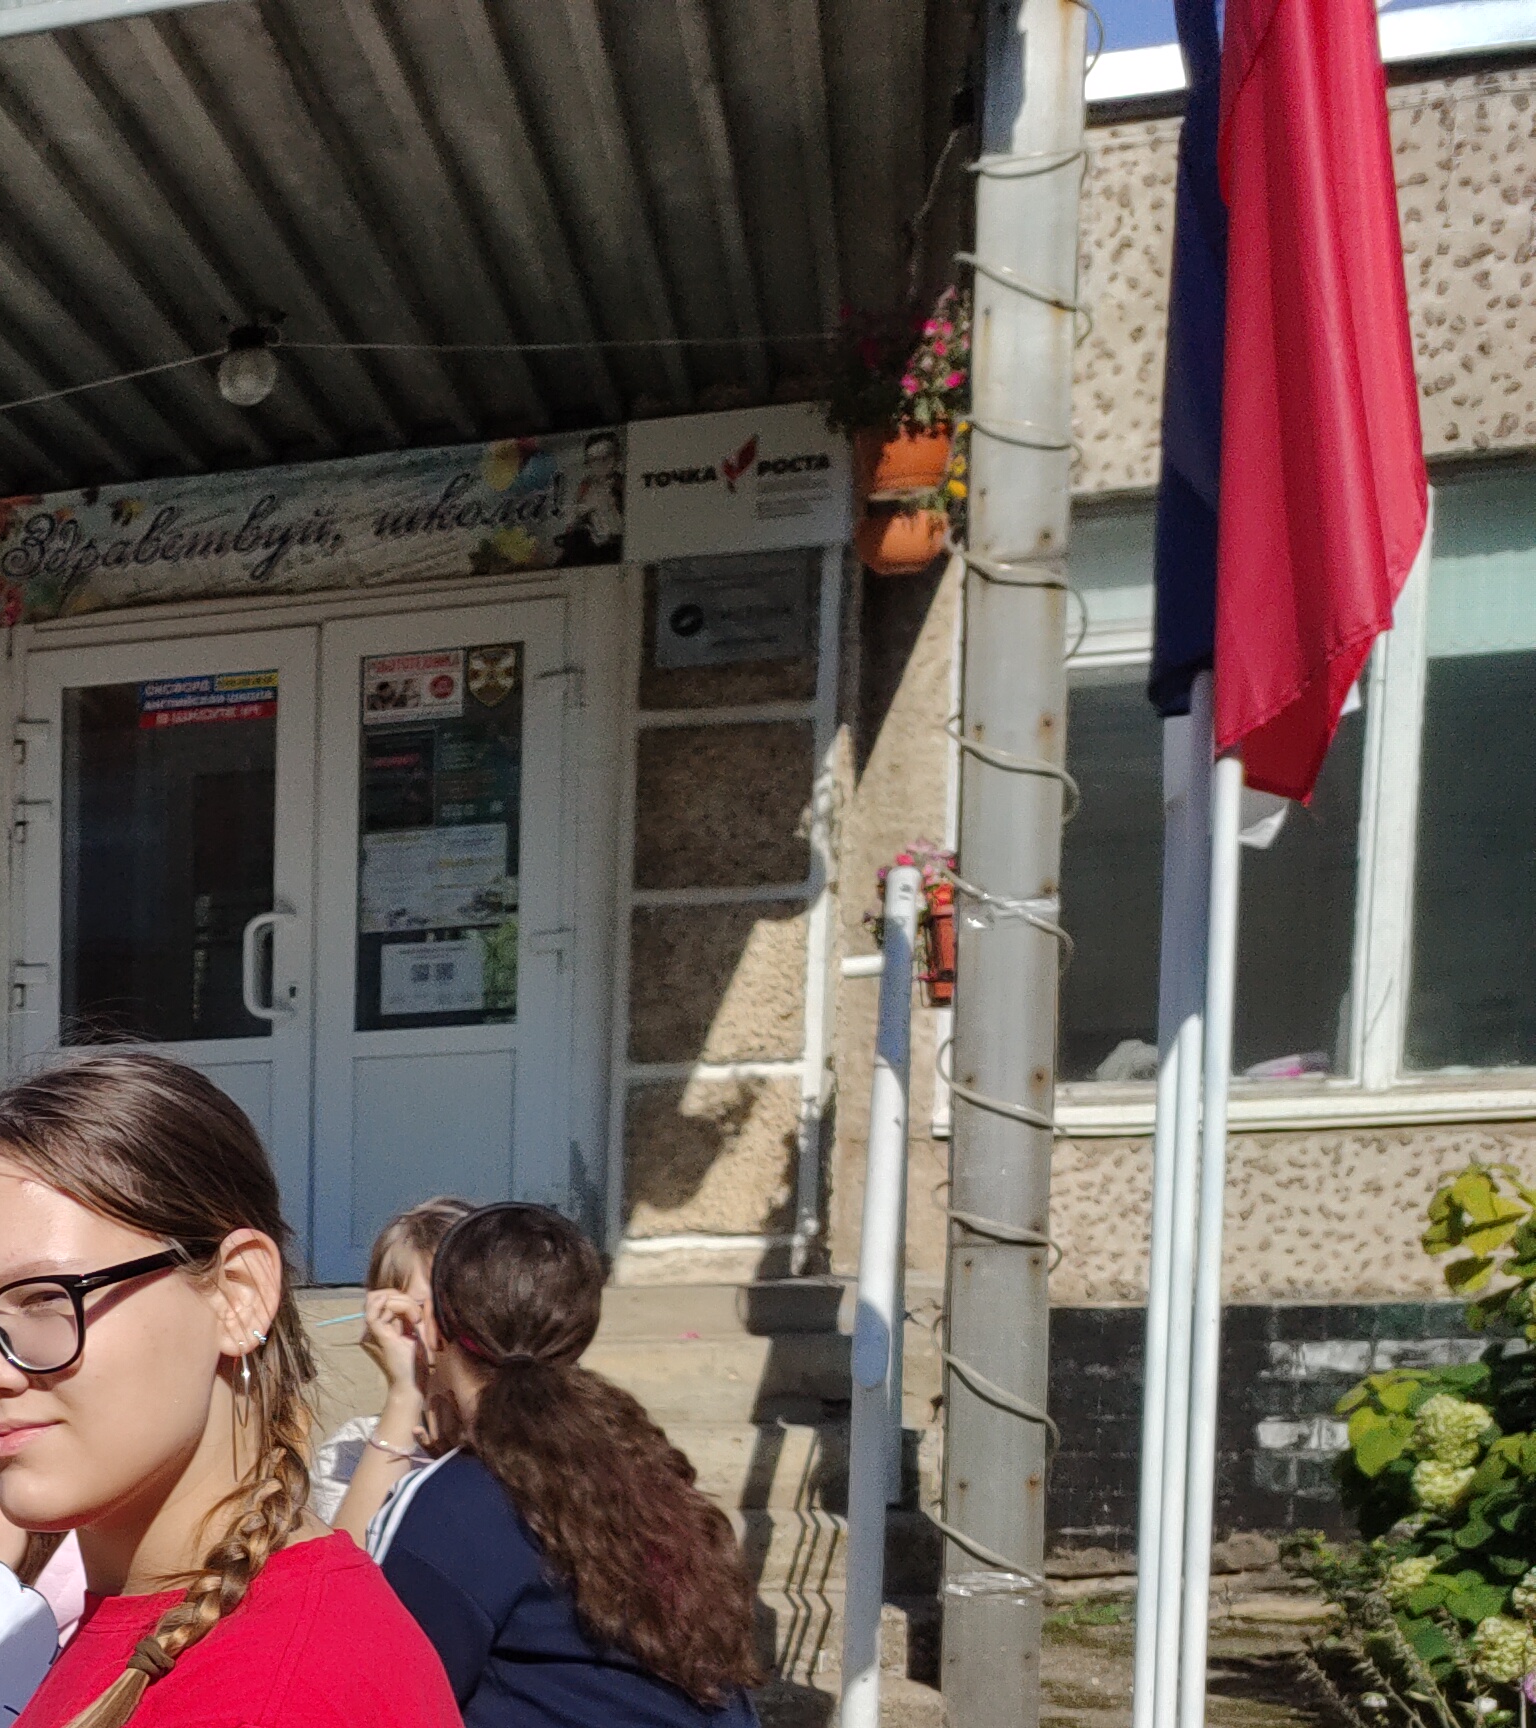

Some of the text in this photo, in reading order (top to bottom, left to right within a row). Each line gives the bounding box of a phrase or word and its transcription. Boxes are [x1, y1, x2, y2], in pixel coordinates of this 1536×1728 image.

[641, 454, 831, 489] ТОЧКА РОСТА
[0, 470, 564, 586] Здравствуй, школа!
